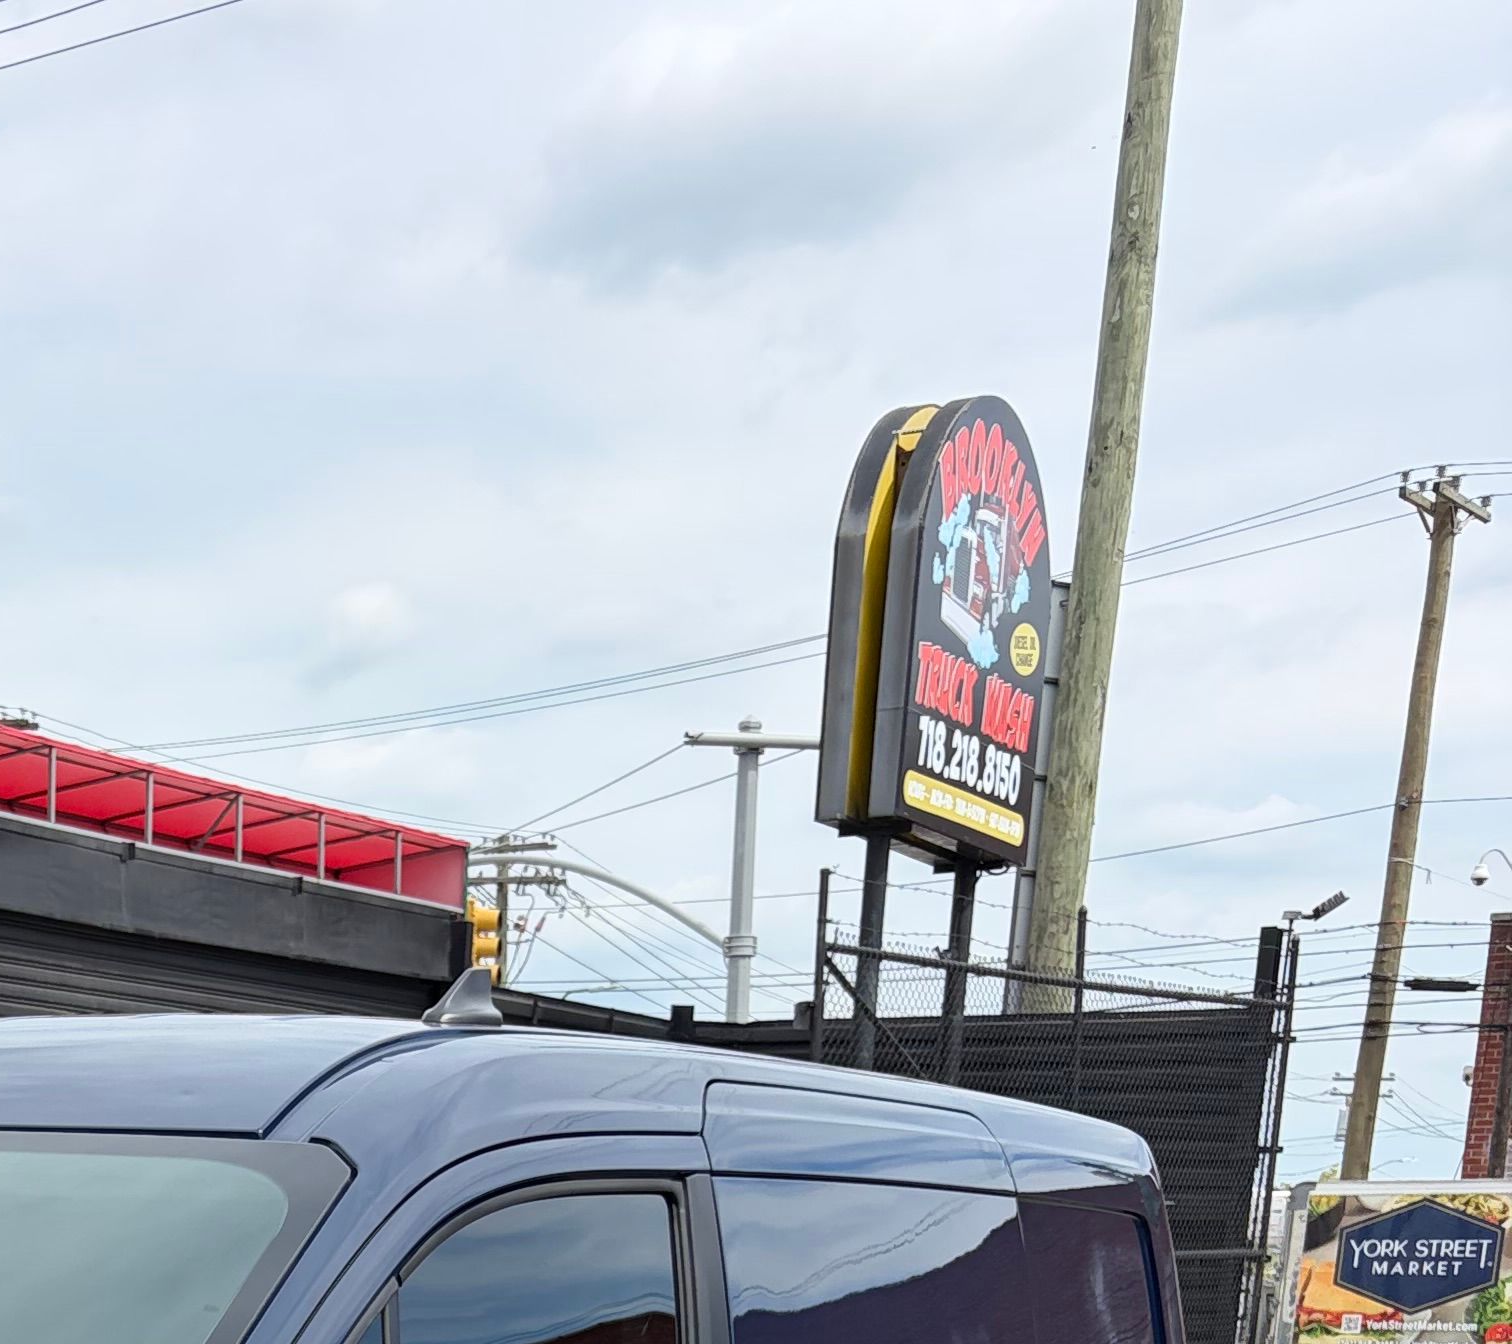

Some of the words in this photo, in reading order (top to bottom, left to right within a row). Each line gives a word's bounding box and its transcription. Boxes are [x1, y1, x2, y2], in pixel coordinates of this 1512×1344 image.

[938, 418, 1046, 567] BROOKLYN
[915, 641, 979, 727] TRUCK
[980, 672, 1035, 753] WASH
[917, 715, 1021, 806] 718.218.8150
[1349, 1238, 1409, 1269] YORK
[1414, 1238, 1493, 1269] STREET
[1371, 1260, 1463, 1276] MARKET
[1366, 1319, 1478, 1331] YorkStreetMarket.com
